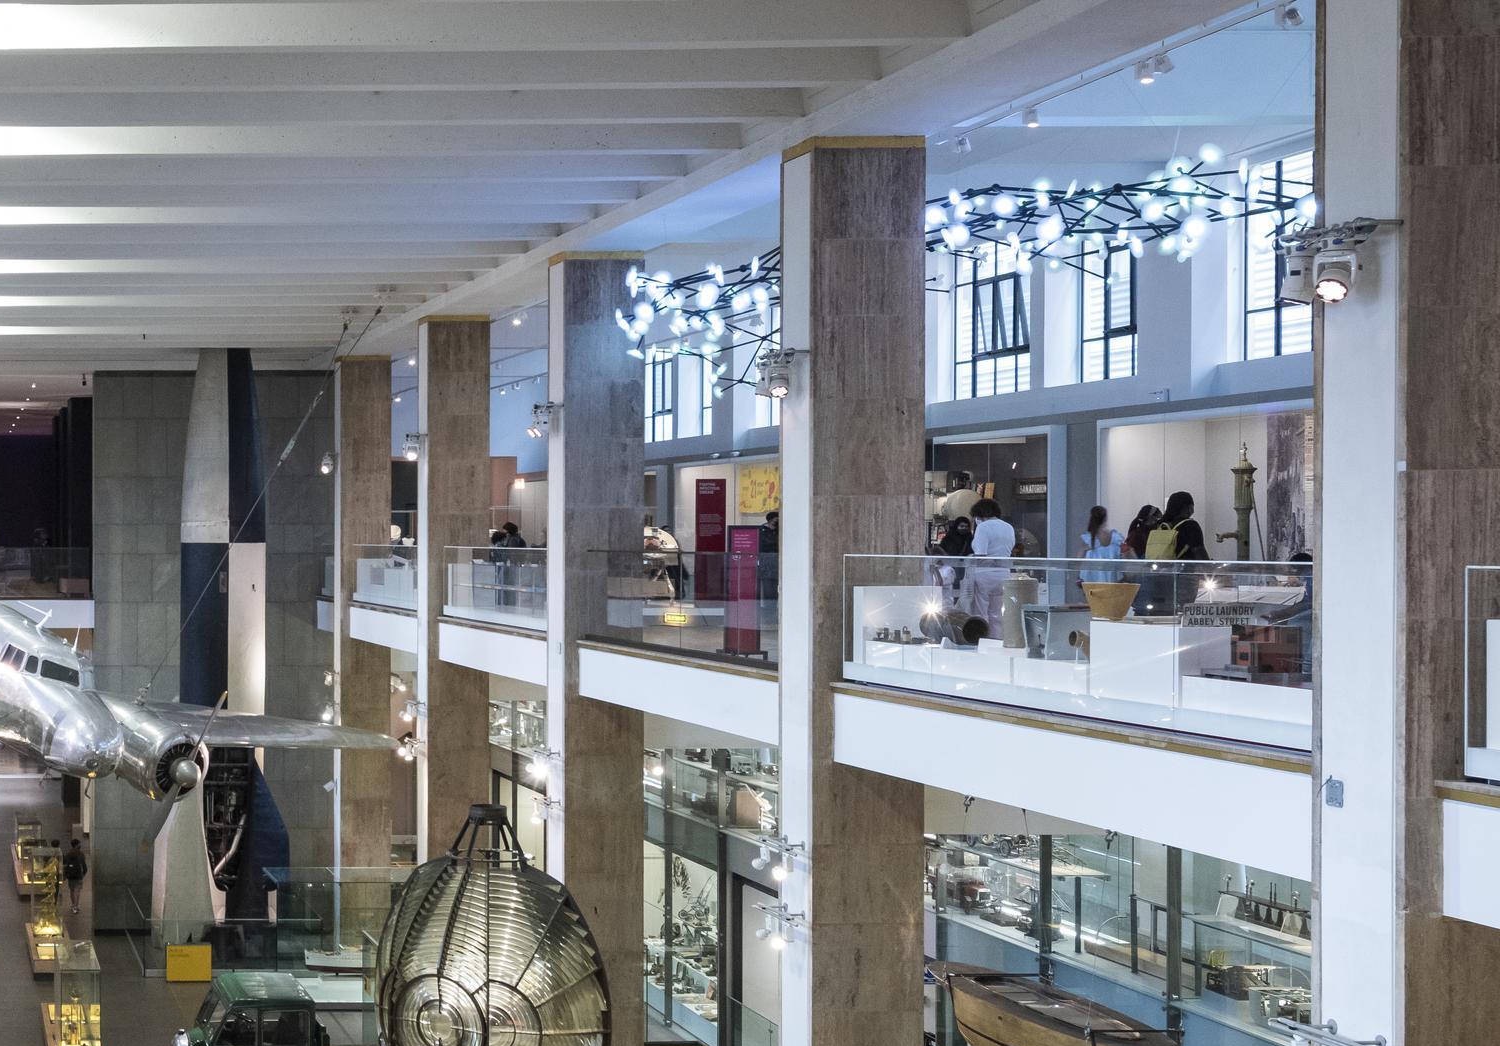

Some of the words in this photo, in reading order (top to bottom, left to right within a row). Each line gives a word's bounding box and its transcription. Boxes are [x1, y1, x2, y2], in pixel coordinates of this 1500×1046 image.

[1184, 605, 1214, 616] PUBLIC
[1216, 605, 1255, 616] LAUNDRY
[1187, 617, 1215, 626] ABBEY
[1219, 617, 1250, 626] STREET
